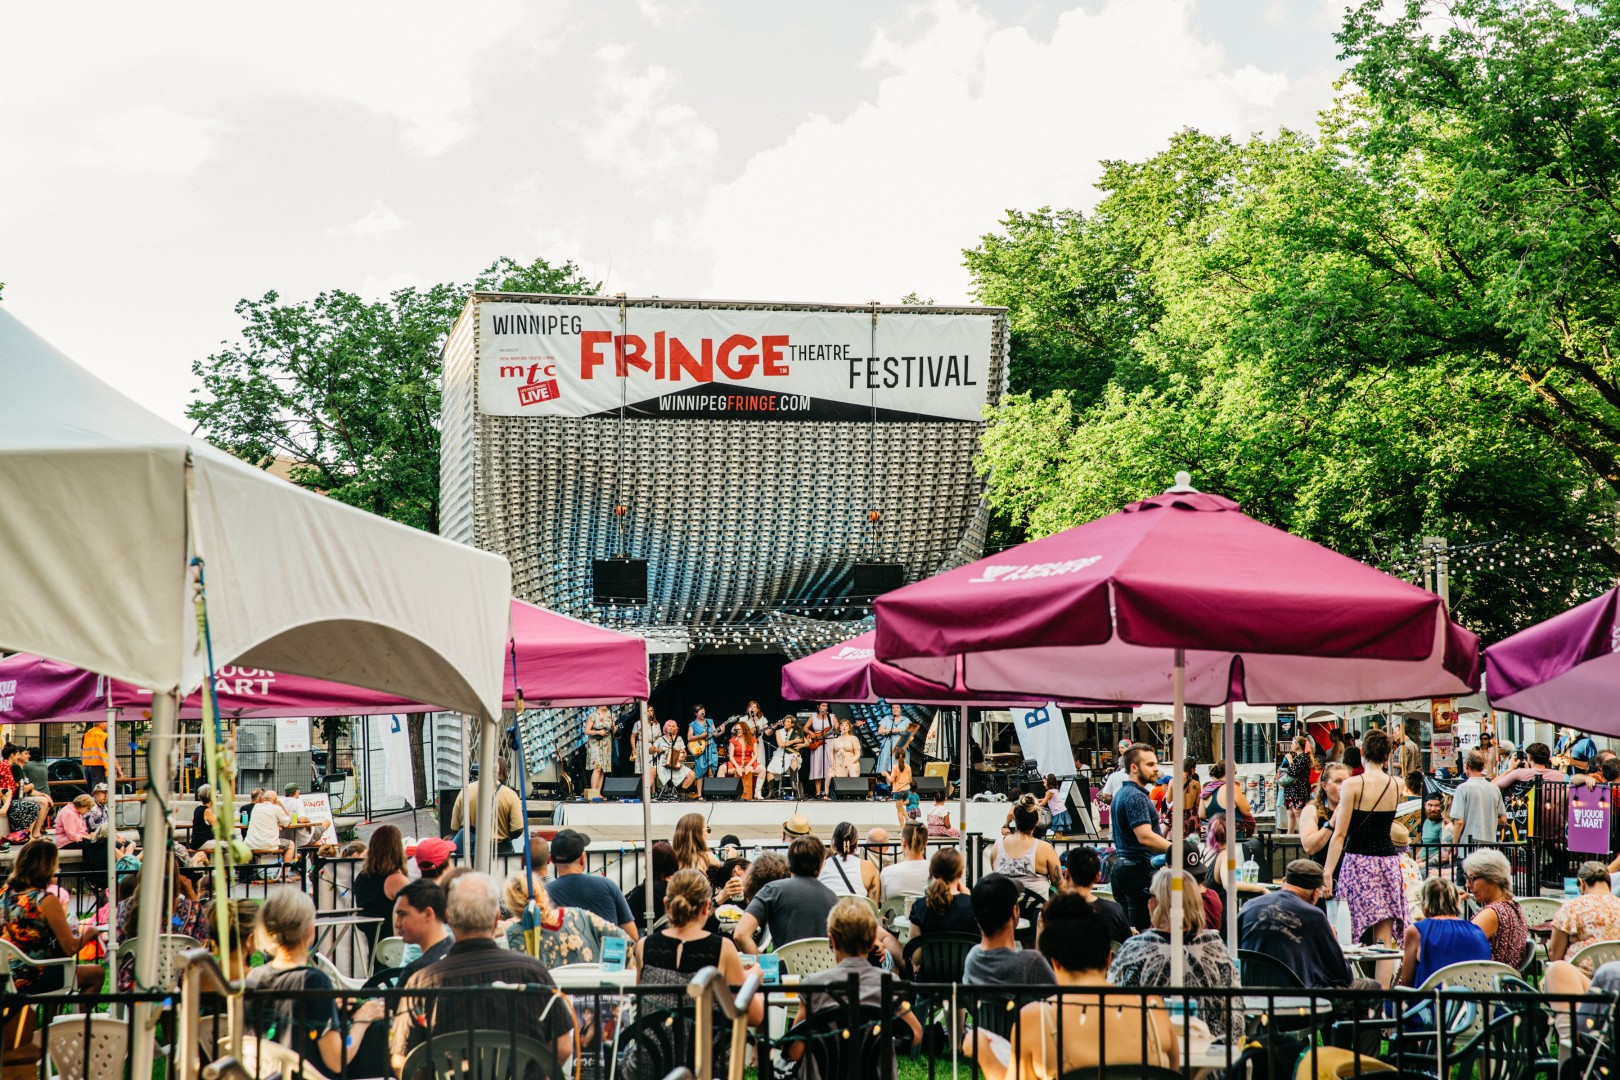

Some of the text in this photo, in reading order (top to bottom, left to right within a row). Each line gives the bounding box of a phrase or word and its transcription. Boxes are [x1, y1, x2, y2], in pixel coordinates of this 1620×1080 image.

[493, 314, 582, 335] WINNIPEG
[580, 330, 789, 383] FRINGE
[790, 344, 850, 361] THEATRE
[500, 362, 556, 385] mtc
[849, 355, 977, 389] FESTIVAL
[521, 388, 549, 403] LIVE
[659, 395, 811, 412] WINNIPEGFRINGE.COM
[213, 678, 276, 695] ART
[1581, 809, 1604, 819] LIQUOR
[1581, 819, 1604, 829] MART
